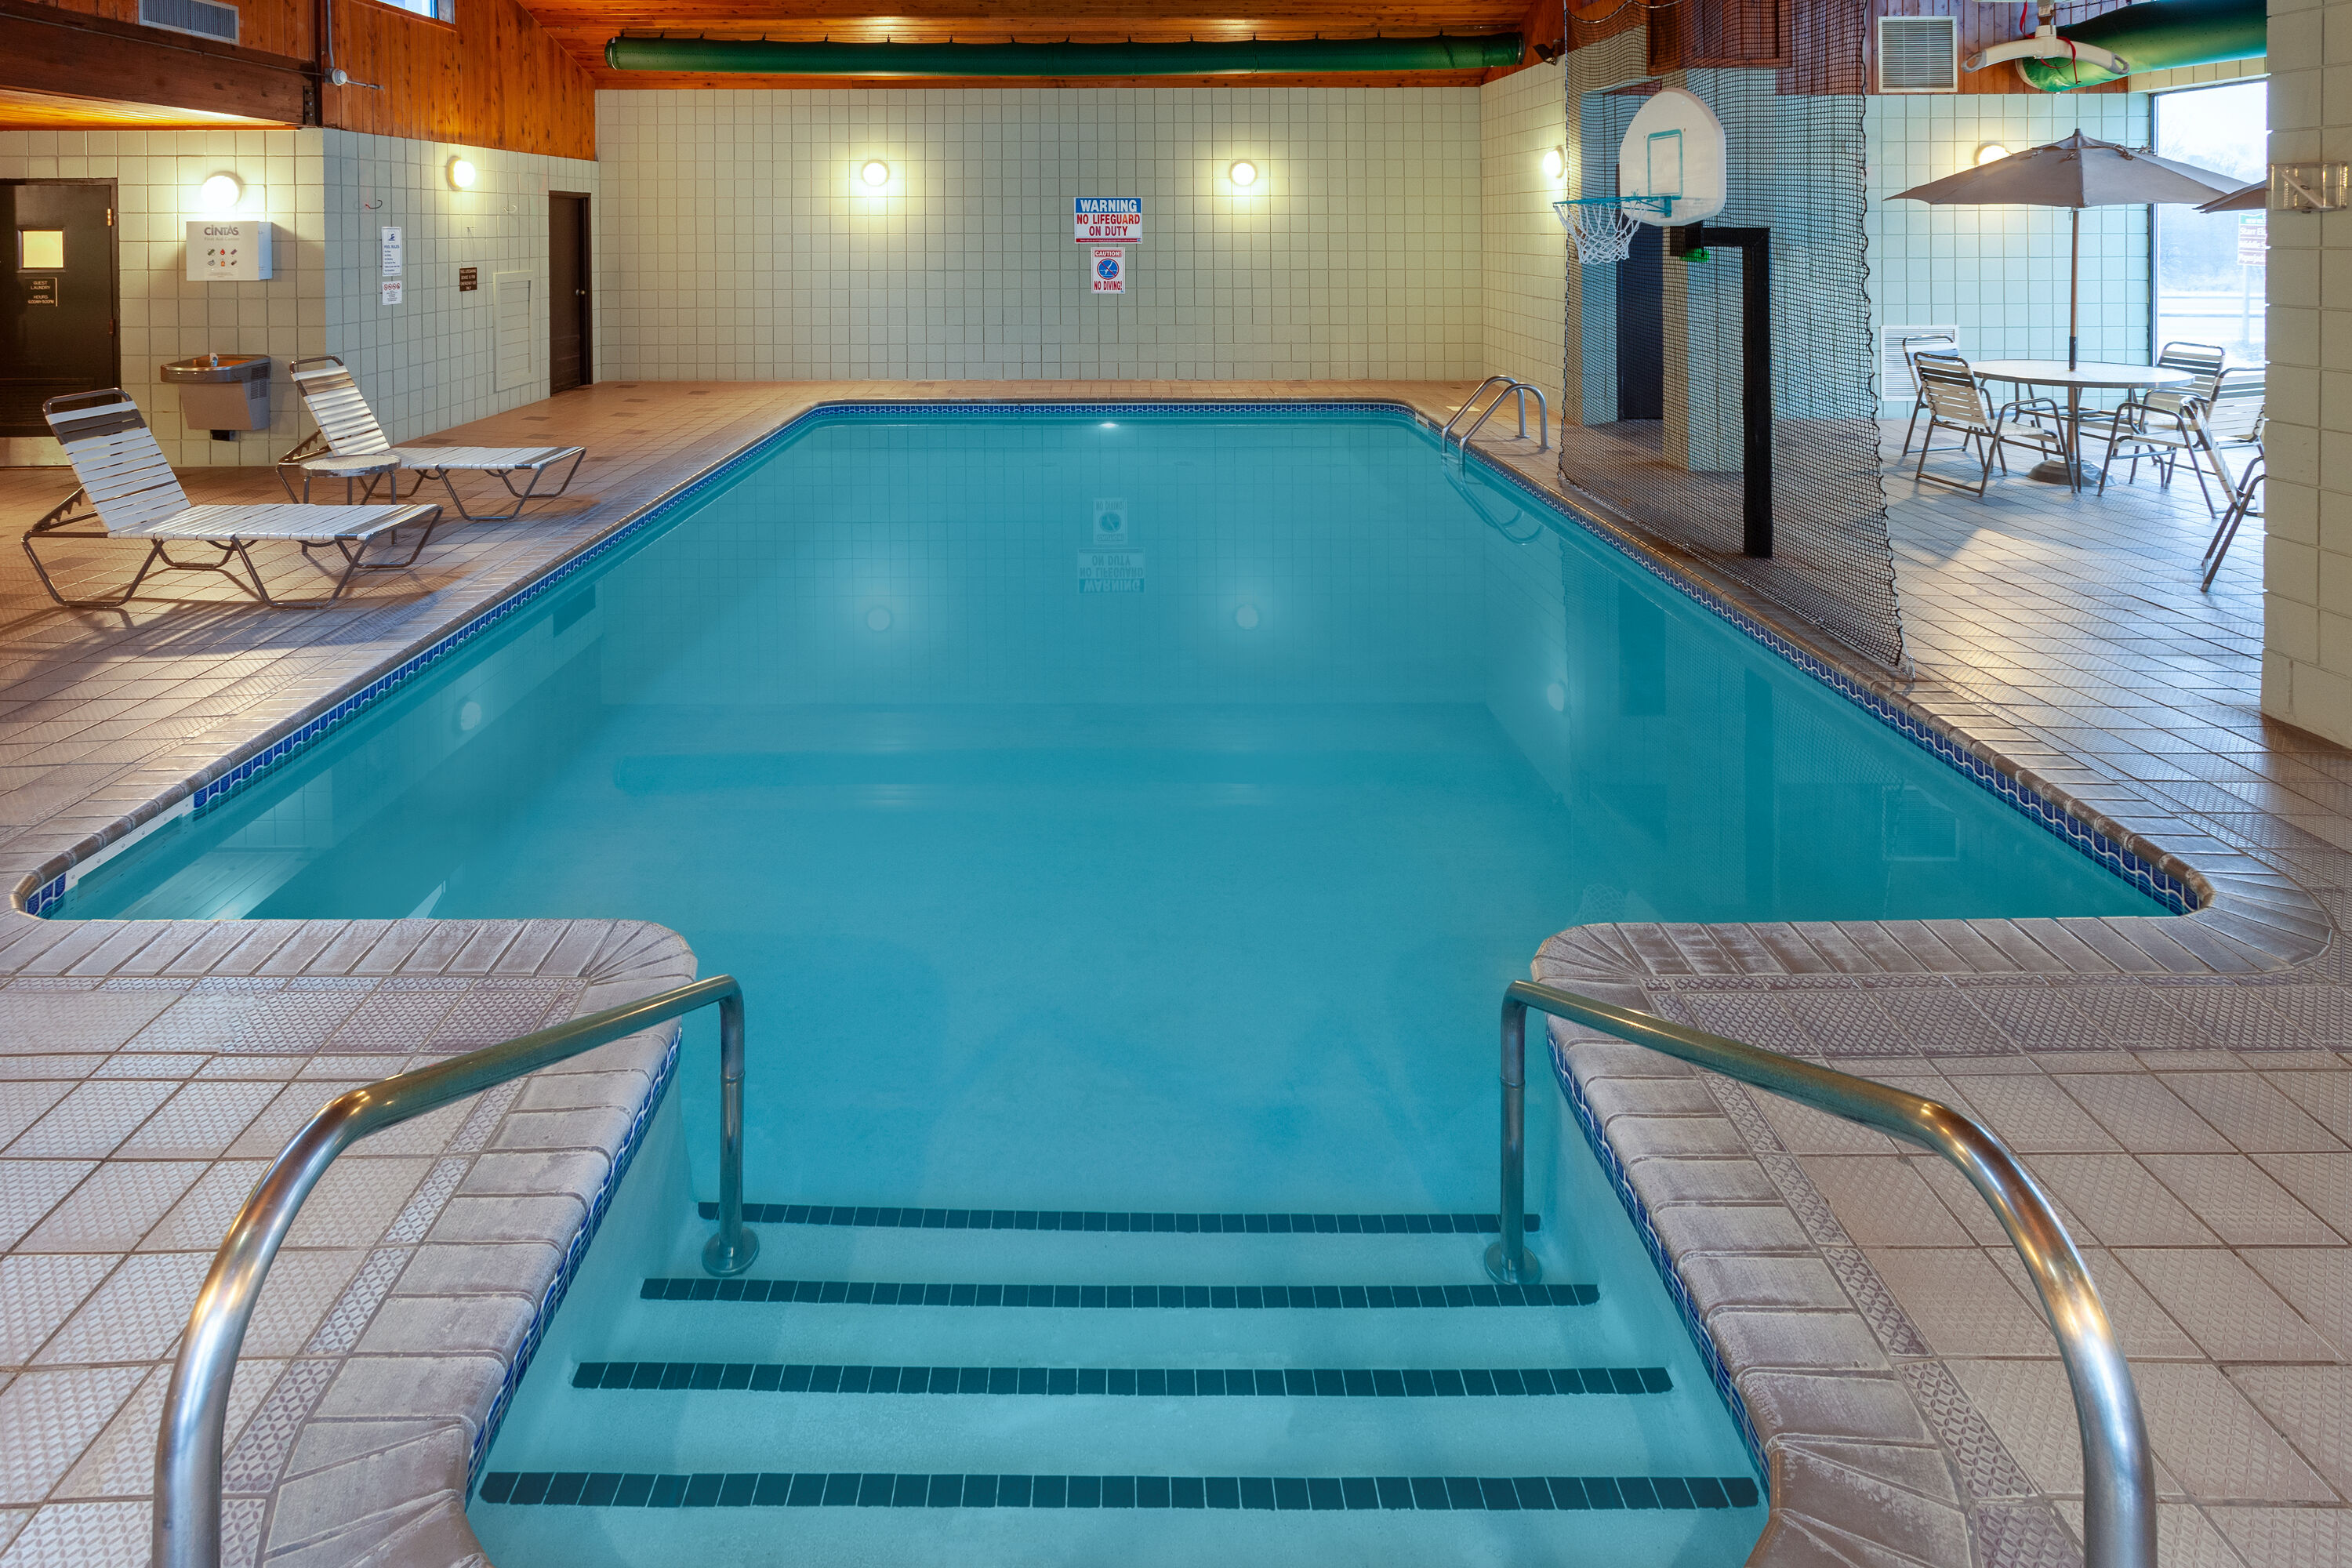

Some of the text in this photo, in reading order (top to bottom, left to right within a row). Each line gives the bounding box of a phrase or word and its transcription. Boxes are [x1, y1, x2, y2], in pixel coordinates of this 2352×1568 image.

[1080, 199, 1137, 212] WARNING
[1076, 214, 1141, 225] NO LIFEGUARD
[1089, 226, 1128, 237] ON DUTY
[1094, 281, 1123, 291] NO DIVING!
